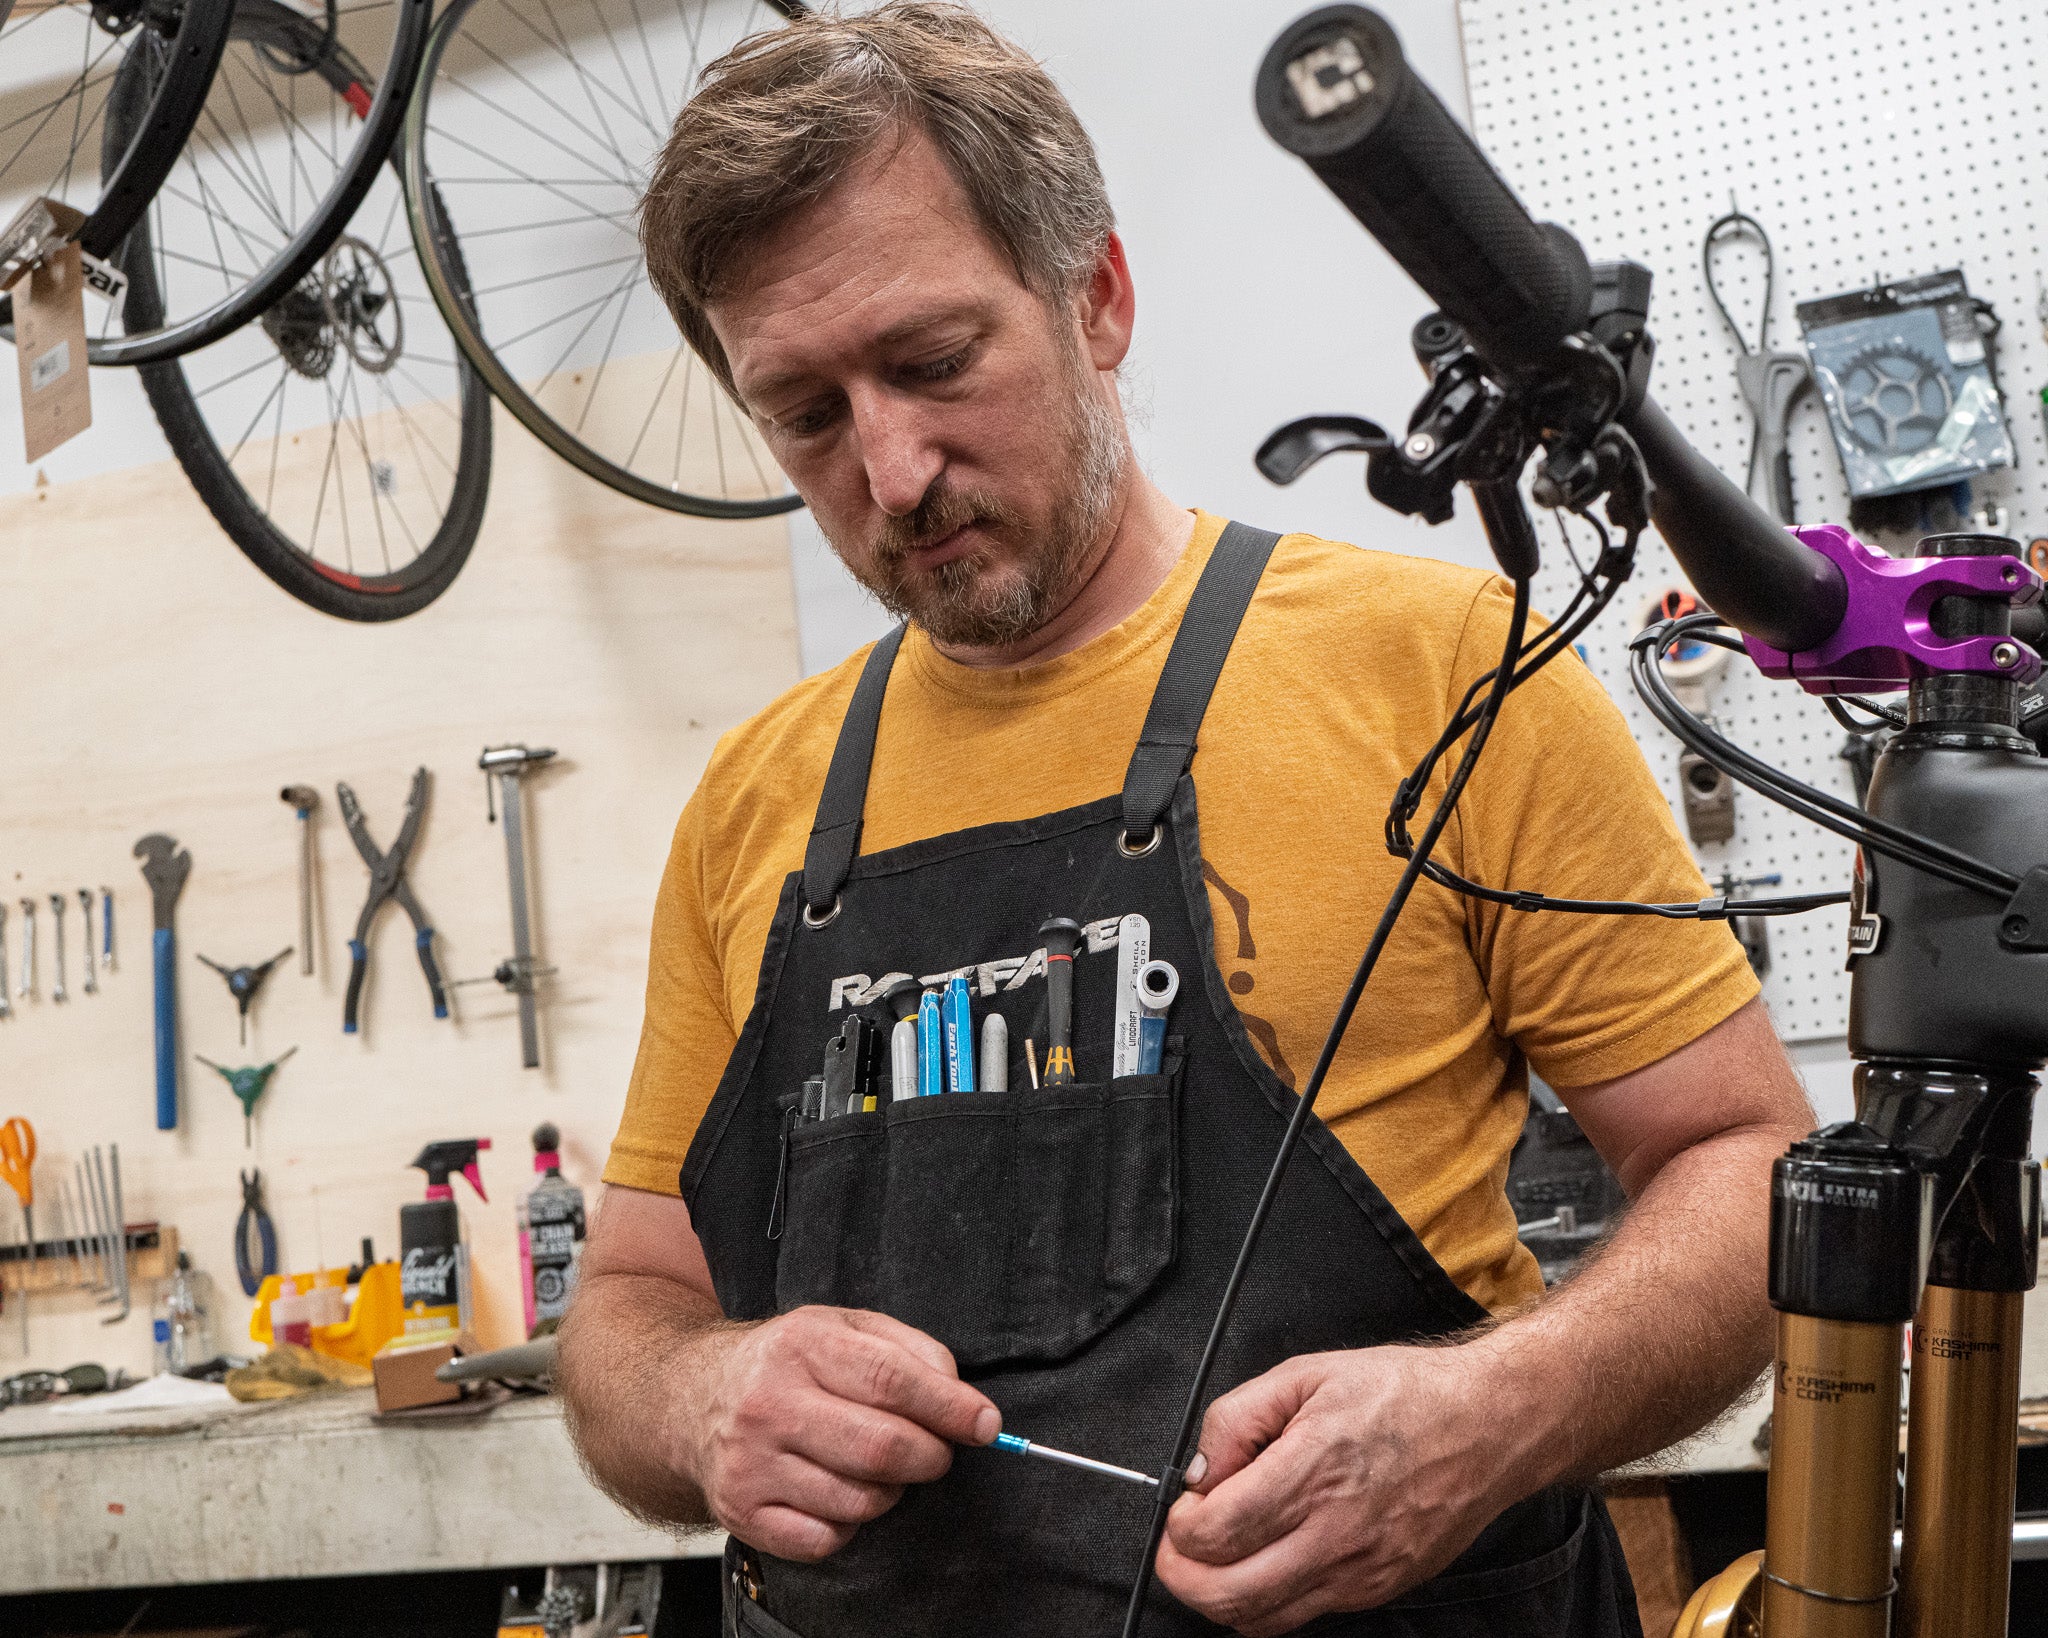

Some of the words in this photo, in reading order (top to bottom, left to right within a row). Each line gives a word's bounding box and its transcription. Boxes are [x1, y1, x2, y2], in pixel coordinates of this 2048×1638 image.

[1825, 1184, 1878, 1200] EXTRA
[1932, 1337, 2001, 1353] KASHIMA
[1931, 1347, 1973, 1361] COAT
[1796, 1376, 1876, 1394] KASHIMA
[1796, 1388, 1844, 1403] COAT
